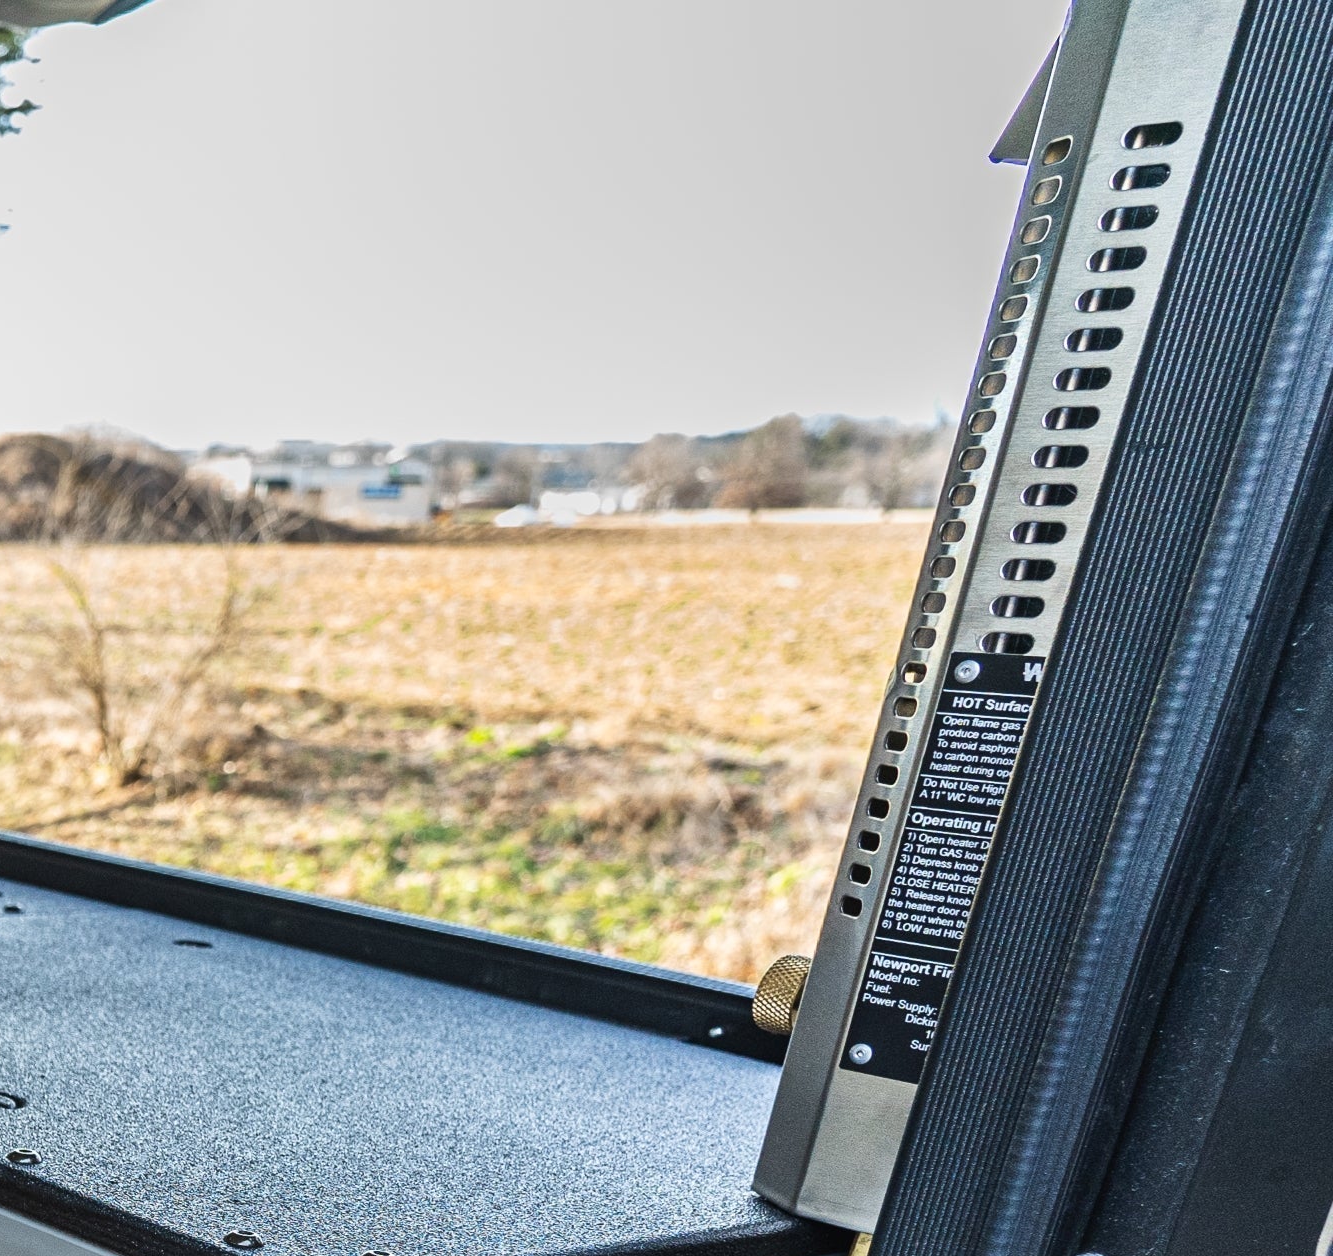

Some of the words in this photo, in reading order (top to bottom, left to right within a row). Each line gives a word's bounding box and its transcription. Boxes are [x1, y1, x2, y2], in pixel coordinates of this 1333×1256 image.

[953, 696, 984, 709] HOT
[943, 716, 969, 726] Open
[972, 718, 1000, 729] flame
[1001, 723, 1020, 731] gas
[939, 728, 979, 739] produce
[981, 732, 1016, 742] carbon
[937, 738, 948, 747] To
[950, 741, 977, 750] avoid
[933, 751, 942, 759] to
[944, 753, 978, 762] carbon
[980, 756, 1014, 766] monox
[929, 762, 961, 772] heater
[963, 765, 994, 777] during
[923, 778, 937, 787] Do
[939, 780, 957, 789] Not
[959, 782, 979, 792] Use
[981, 784, 1005, 795] High
[919, 790, 928, 798] A
[947, 791, 967, 802] WC
[967, 795, 985, 804] low
[986, 798, 1003, 806] pre
[912, 812, 981, 833] Operating
[908, 832, 916, 842] 1)
[918, 833, 945, 845] Open
[947, 837, 979, 849] heater
[980, 841, 990, 849] D
[903, 843, 913, 853] 2)
[916, 844, 937, 855] Turn
[939, 848, 963, 858] GAS
[964, 851, 987, 862] knob
[900, 854, 910, 864] 3)
[912, 856, 952, 869] Depress
[954, 861, 978, 872] knob
[897, 866, 907, 875] 4)
[909, 867, 934, 879] Keep
[936, 871, 960, 881] knob
[962, 875, 981, 885] dep
[894, 876, 930, 889] CLOSE
[932, 881, 975, 895] HEATER
[891, 887, 901, 896] 5)
[906, 889, 945, 902] Release
[947, 895, 971, 906] knob
[888, 898, 903, 907] the
[905, 900, 936, 912] heater
[937, 906, 960, 916] door
[885, 910, 894, 918] to
[896, 912, 908, 920] go
[911, 914, 927, 922] out
[928, 916, 953, 927] when
[881, 920, 892, 929] 6)
[896, 921, 923, 933] LOW
[923, 928, 942, 937] and
[872, 955, 931, 975] Newport
[869, 969, 902, 983] Model
[903, 977, 921, 986] no:
[866, 981, 892, 994] Fuel:
[862, 993, 897, 1007] Power
[898, 1000, 938, 1017] Supply:
